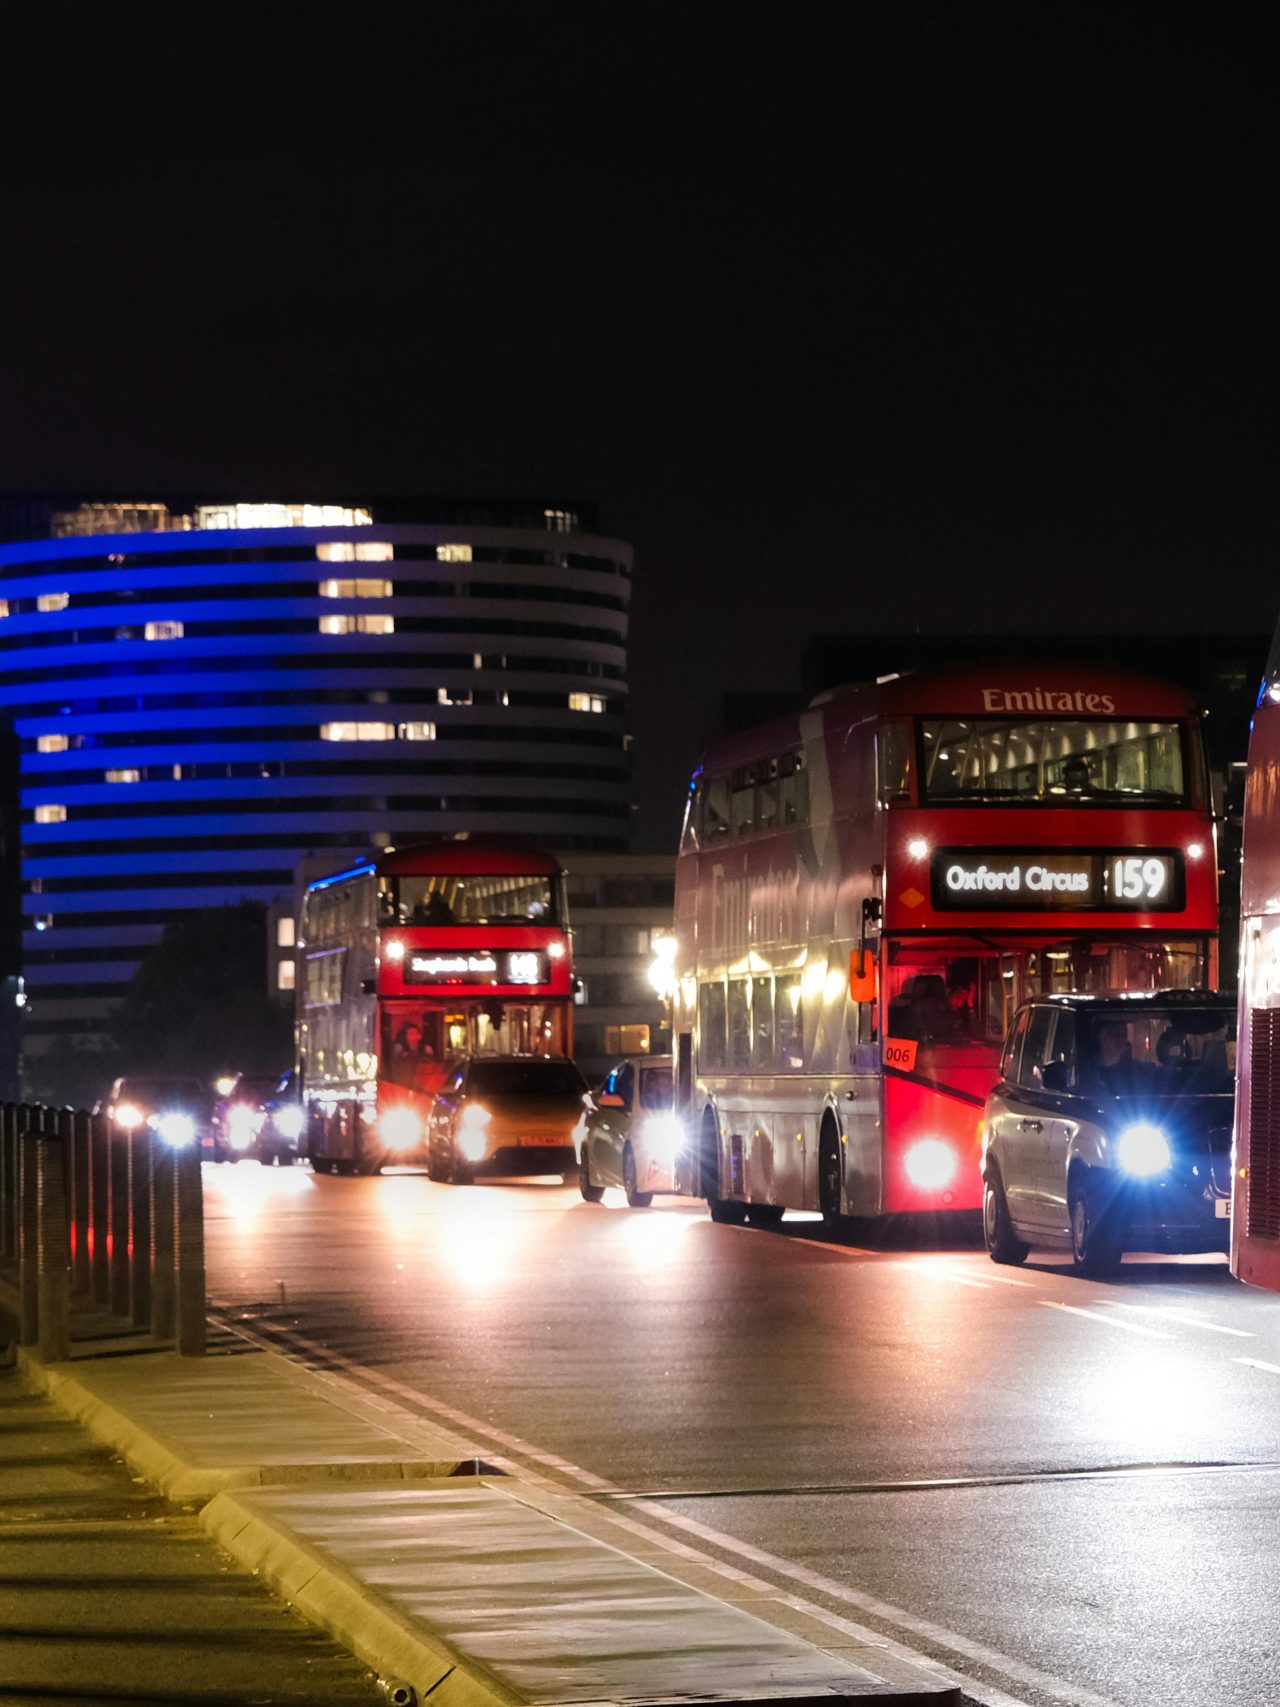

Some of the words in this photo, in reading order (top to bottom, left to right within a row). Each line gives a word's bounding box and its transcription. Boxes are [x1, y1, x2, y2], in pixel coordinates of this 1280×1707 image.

[983, 687, 1115, 713] Emirates
[946, 865, 1020, 890] Oxford
[1025, 866, 1089, 891] Circus
[1114, 859, 1166, 898] 159
[886, 1047, 910, 1063] 006
